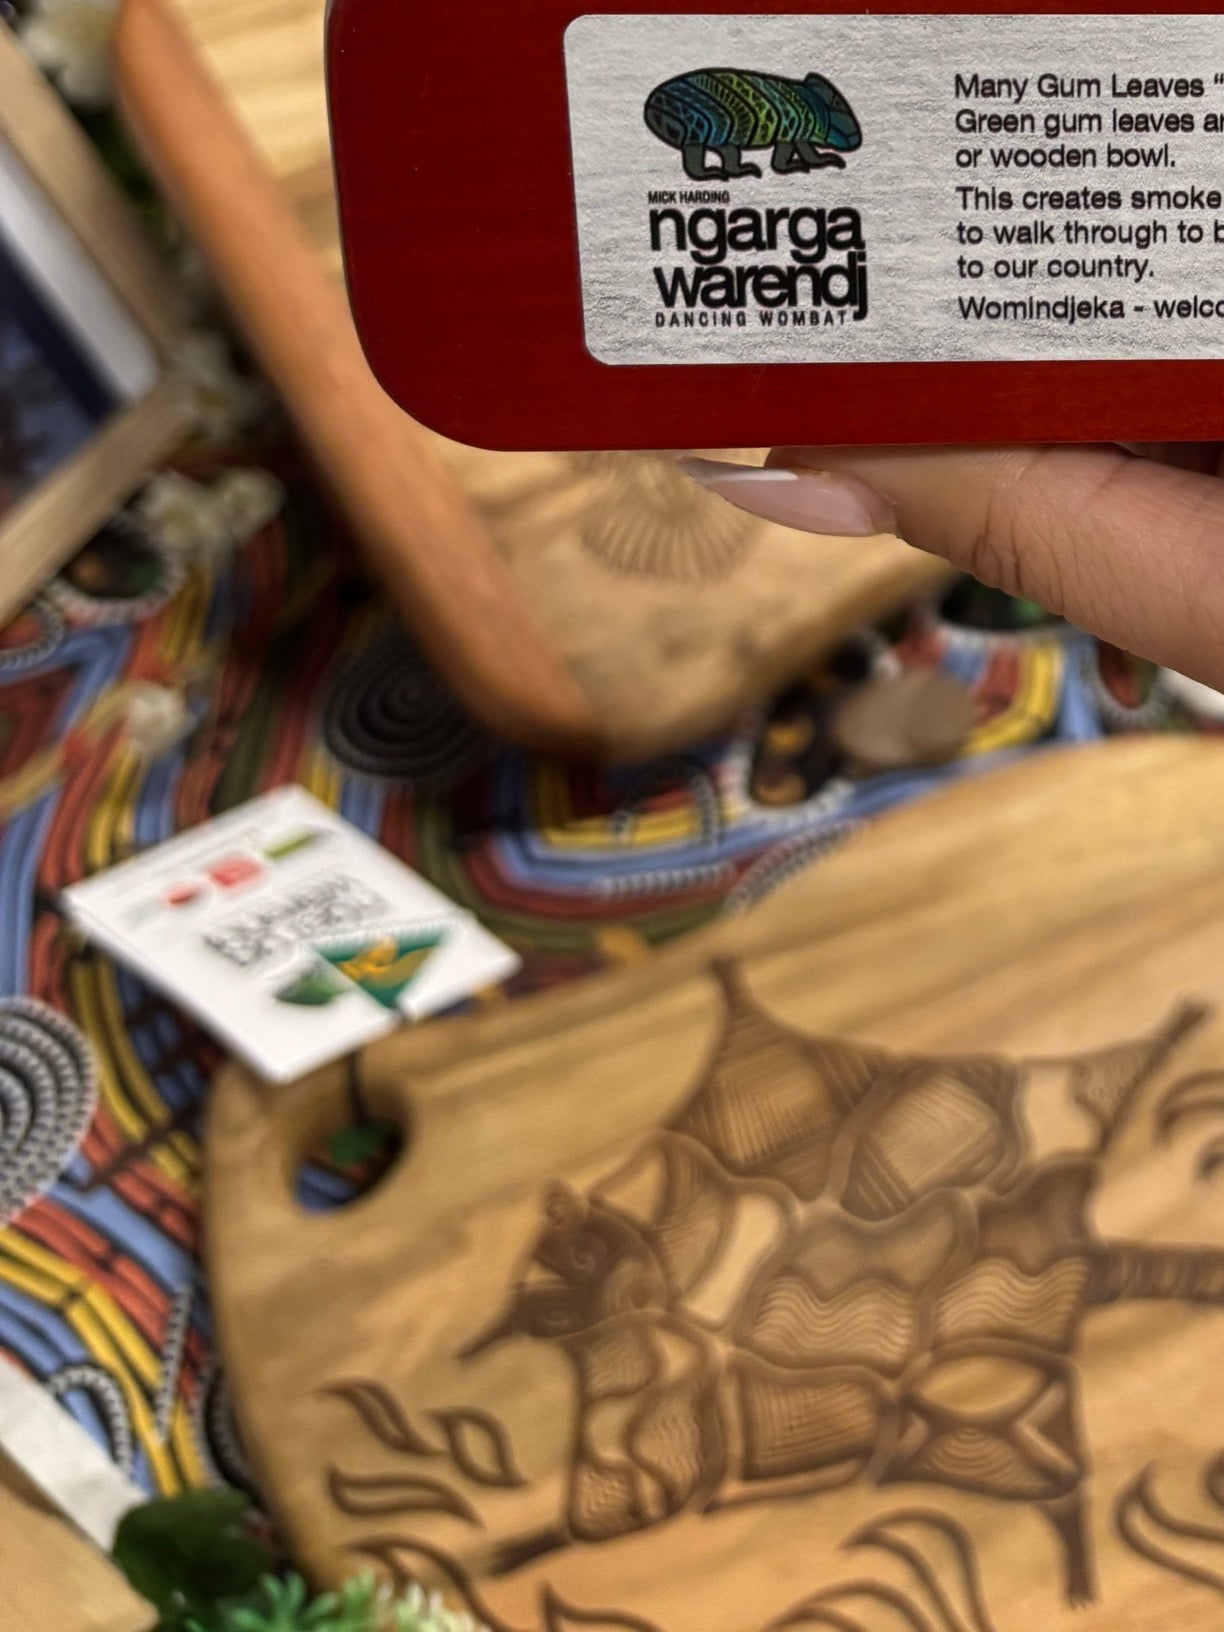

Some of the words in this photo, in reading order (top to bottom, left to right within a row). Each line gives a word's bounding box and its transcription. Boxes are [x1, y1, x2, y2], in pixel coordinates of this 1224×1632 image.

[953, 72, 1030, 105] Many
[1036, 72, 1102, 99] Gum
[1110, 72, 1206, 99] Leaves
[954, 108, 1036, 135] Green
[1043, 112, 1103, 140] gum
[1111, 107, 1196, 134] leaves
[954, 147, 984, 169] or
[989, 143, 1098, 169] wooden
[1106, 142, 1176, 169] bowl.
[648, 191, 677, 203] MICK
[679, 190, 730, 203] HARDING
[954, 185, 1015, 211] This
[1021, 185, 1124, 211] creates
[649, 207, 866, 264] ngarga
[956, 220, 985, 246] to
[991, 219, 1056, 246] walk
[1062, 219, 1168, 251] through
[1176, 219, 1205, 245] to
[653, 250, 868, 320] warendj
[955, 254, 985, 280] to
[992, 259, 1039, 280] our
[1046, 254, 1155, 285] country.
[655, 311, 747, 327] DANCING
[759, 310, 846, 326] WOMBAT
[957, 296, 1126, 326] Womindjeka
